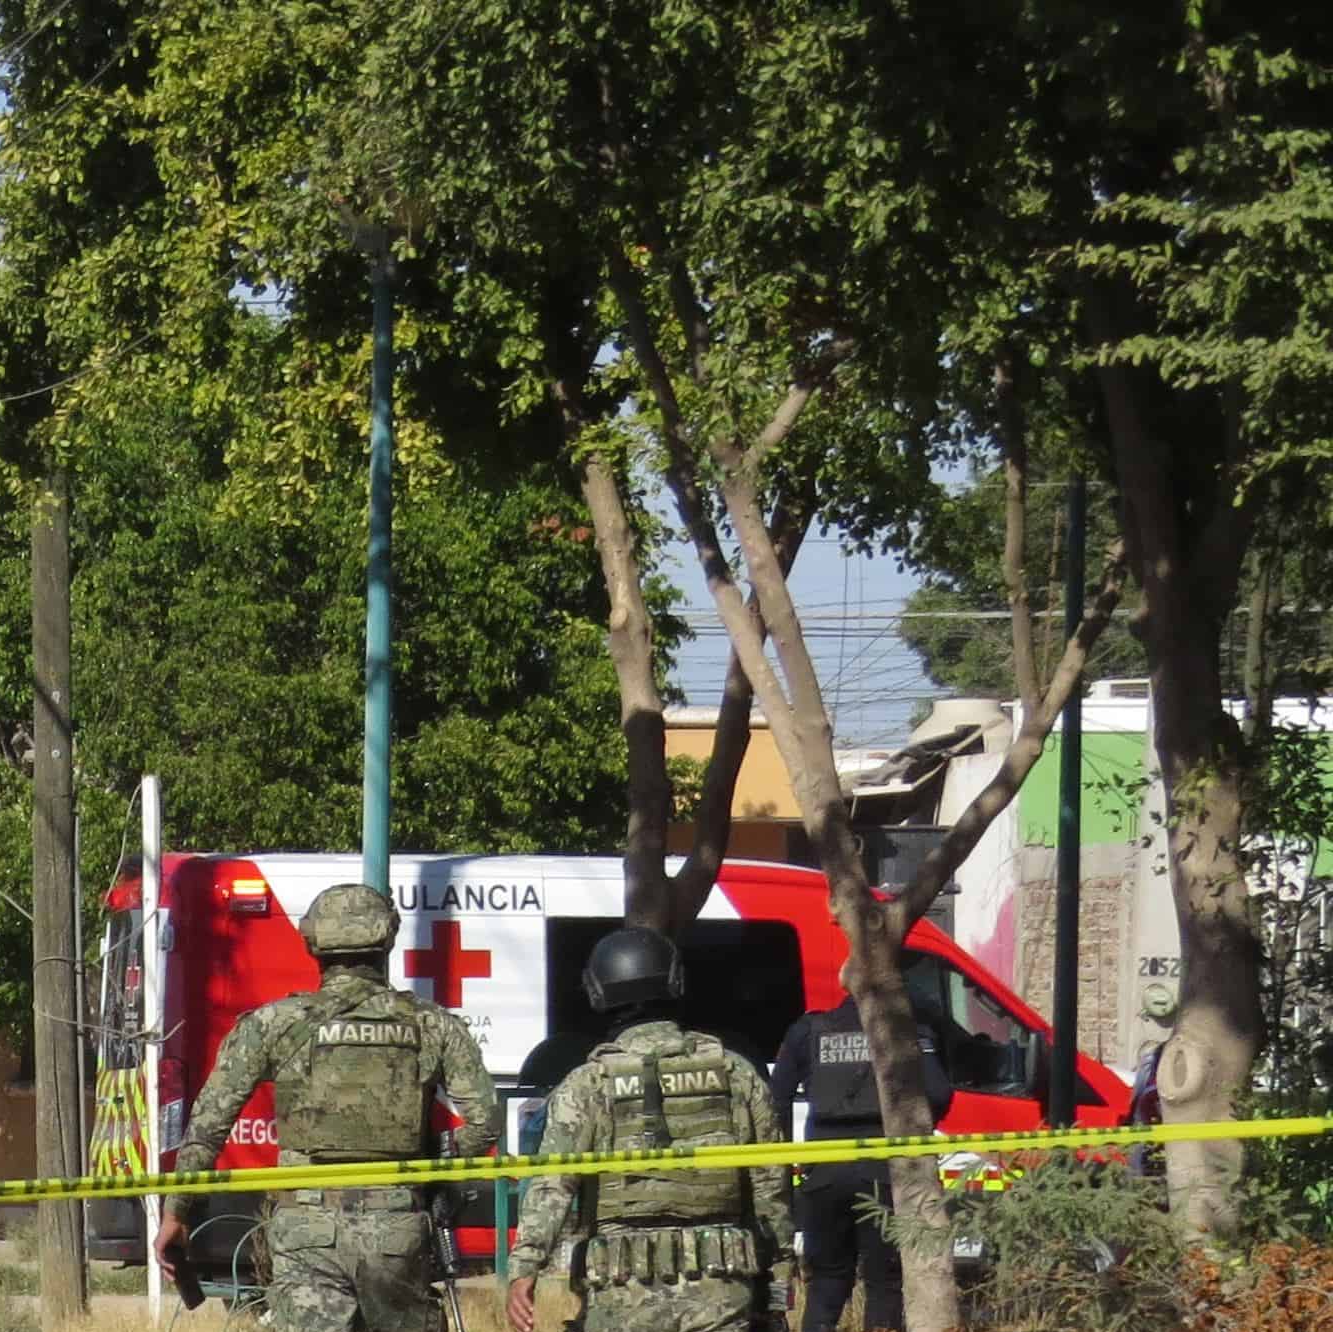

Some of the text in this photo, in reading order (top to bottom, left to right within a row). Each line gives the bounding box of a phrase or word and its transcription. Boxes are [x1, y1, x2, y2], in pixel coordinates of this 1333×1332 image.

[387, 884, 542, 911] ULANCIA
[318, 1023, 417, 1043] MARINA
[819, 1034, 869, 1050] POLICI
[819, 1048, 871, 1063] ESTATA
[614, 1069, 722, 1096] MRINA
